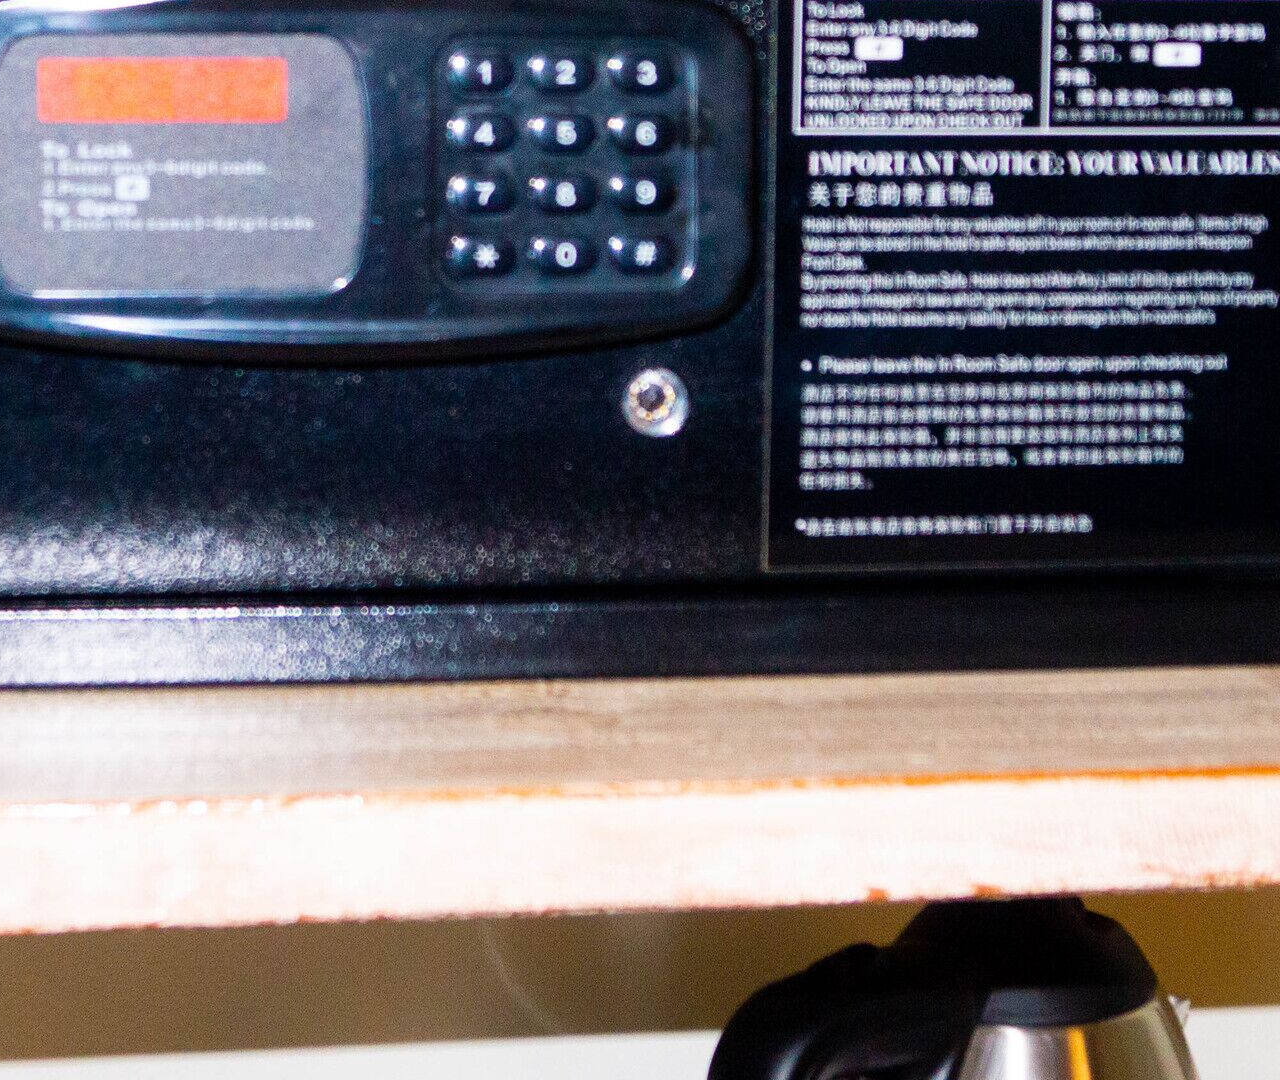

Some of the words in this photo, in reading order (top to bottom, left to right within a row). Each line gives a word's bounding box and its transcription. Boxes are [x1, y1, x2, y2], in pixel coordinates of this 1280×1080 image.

[806, 1, 827, 18] To
[827, 1, 864, 18] Lock
[806, 20, 848, 37] Enter
[848, 20, 876, 39] any
[901, 20, 937, 39] Digit
[938, 20, 977, 37] Code
[806, 38, 849, 56] Press
[476, 59, 492, 86] 1
[555, 59, 577, 86] 2
[636, 59, 658, 86] 3
[806, 57, 826, 74] To
[827, 57, 866, 76] Open
[806, 76, 848, 93] Enter
[848, 76, 873, 93] the
[872, 76, 912, 93] same
[938, 76, 974, 95] Digit
[974, 76, 1014, 93] Code
[805, 94, 863, 111] KINDLY
[863, 94, 911, 111] LEAVE
[913, 94, 943, 111] THE
[944, 94, 986, 111] SAFE
[987, 94, 1032, 111] DOOR
[805, 112, 892, 128] UNLOCKED
[892, 112, 937, 128] UPON
[937, 112, 990, 128] CHECK
[990, 112, 1023, 128] OUT
[473, 121, 495, 147] 4
[555, 120, 577, 146] 5
[635, 120, 657, 147] 6
[41, 140, 70, 159] To
[76, 140, 133, 160] Lock
[808, 151, 958, 175] IMPORTANT
[961, 151, 1064, 175] NOTICE:
[1066, 151, 1138, 175] YOUR
[474, 181, 495, 207] 7
[555, 181, 577, 207] 8
[634, 179, 657, 206] 9
[807, 182, 993, 207] 关于您的贵重物品
[40, 199, 70, 217] To
[76, 199, 139, 219] Open
[803, 217, 833, 233] Hotel
[634, 241, 656, 267] #
[802, 235, 836, 251] Value
[1196, 234, 1252, 252] Reception
[555, 241, 577, 268] 0
[905, 272, 939, 288] Room
[819, 356, 871, 372] Please
[870, 355, 911, 371] leave
[911, 355, 936, 371] the
[953, 355, 996, 371] Room
[996, 355, 1031, 371] Safe
[1031, 354, 1064, 370] door
[1064, 354, 1101, 372] open
[1102, 354, 1140, 372] upon
[1139, 354, 1202, 372] checking
